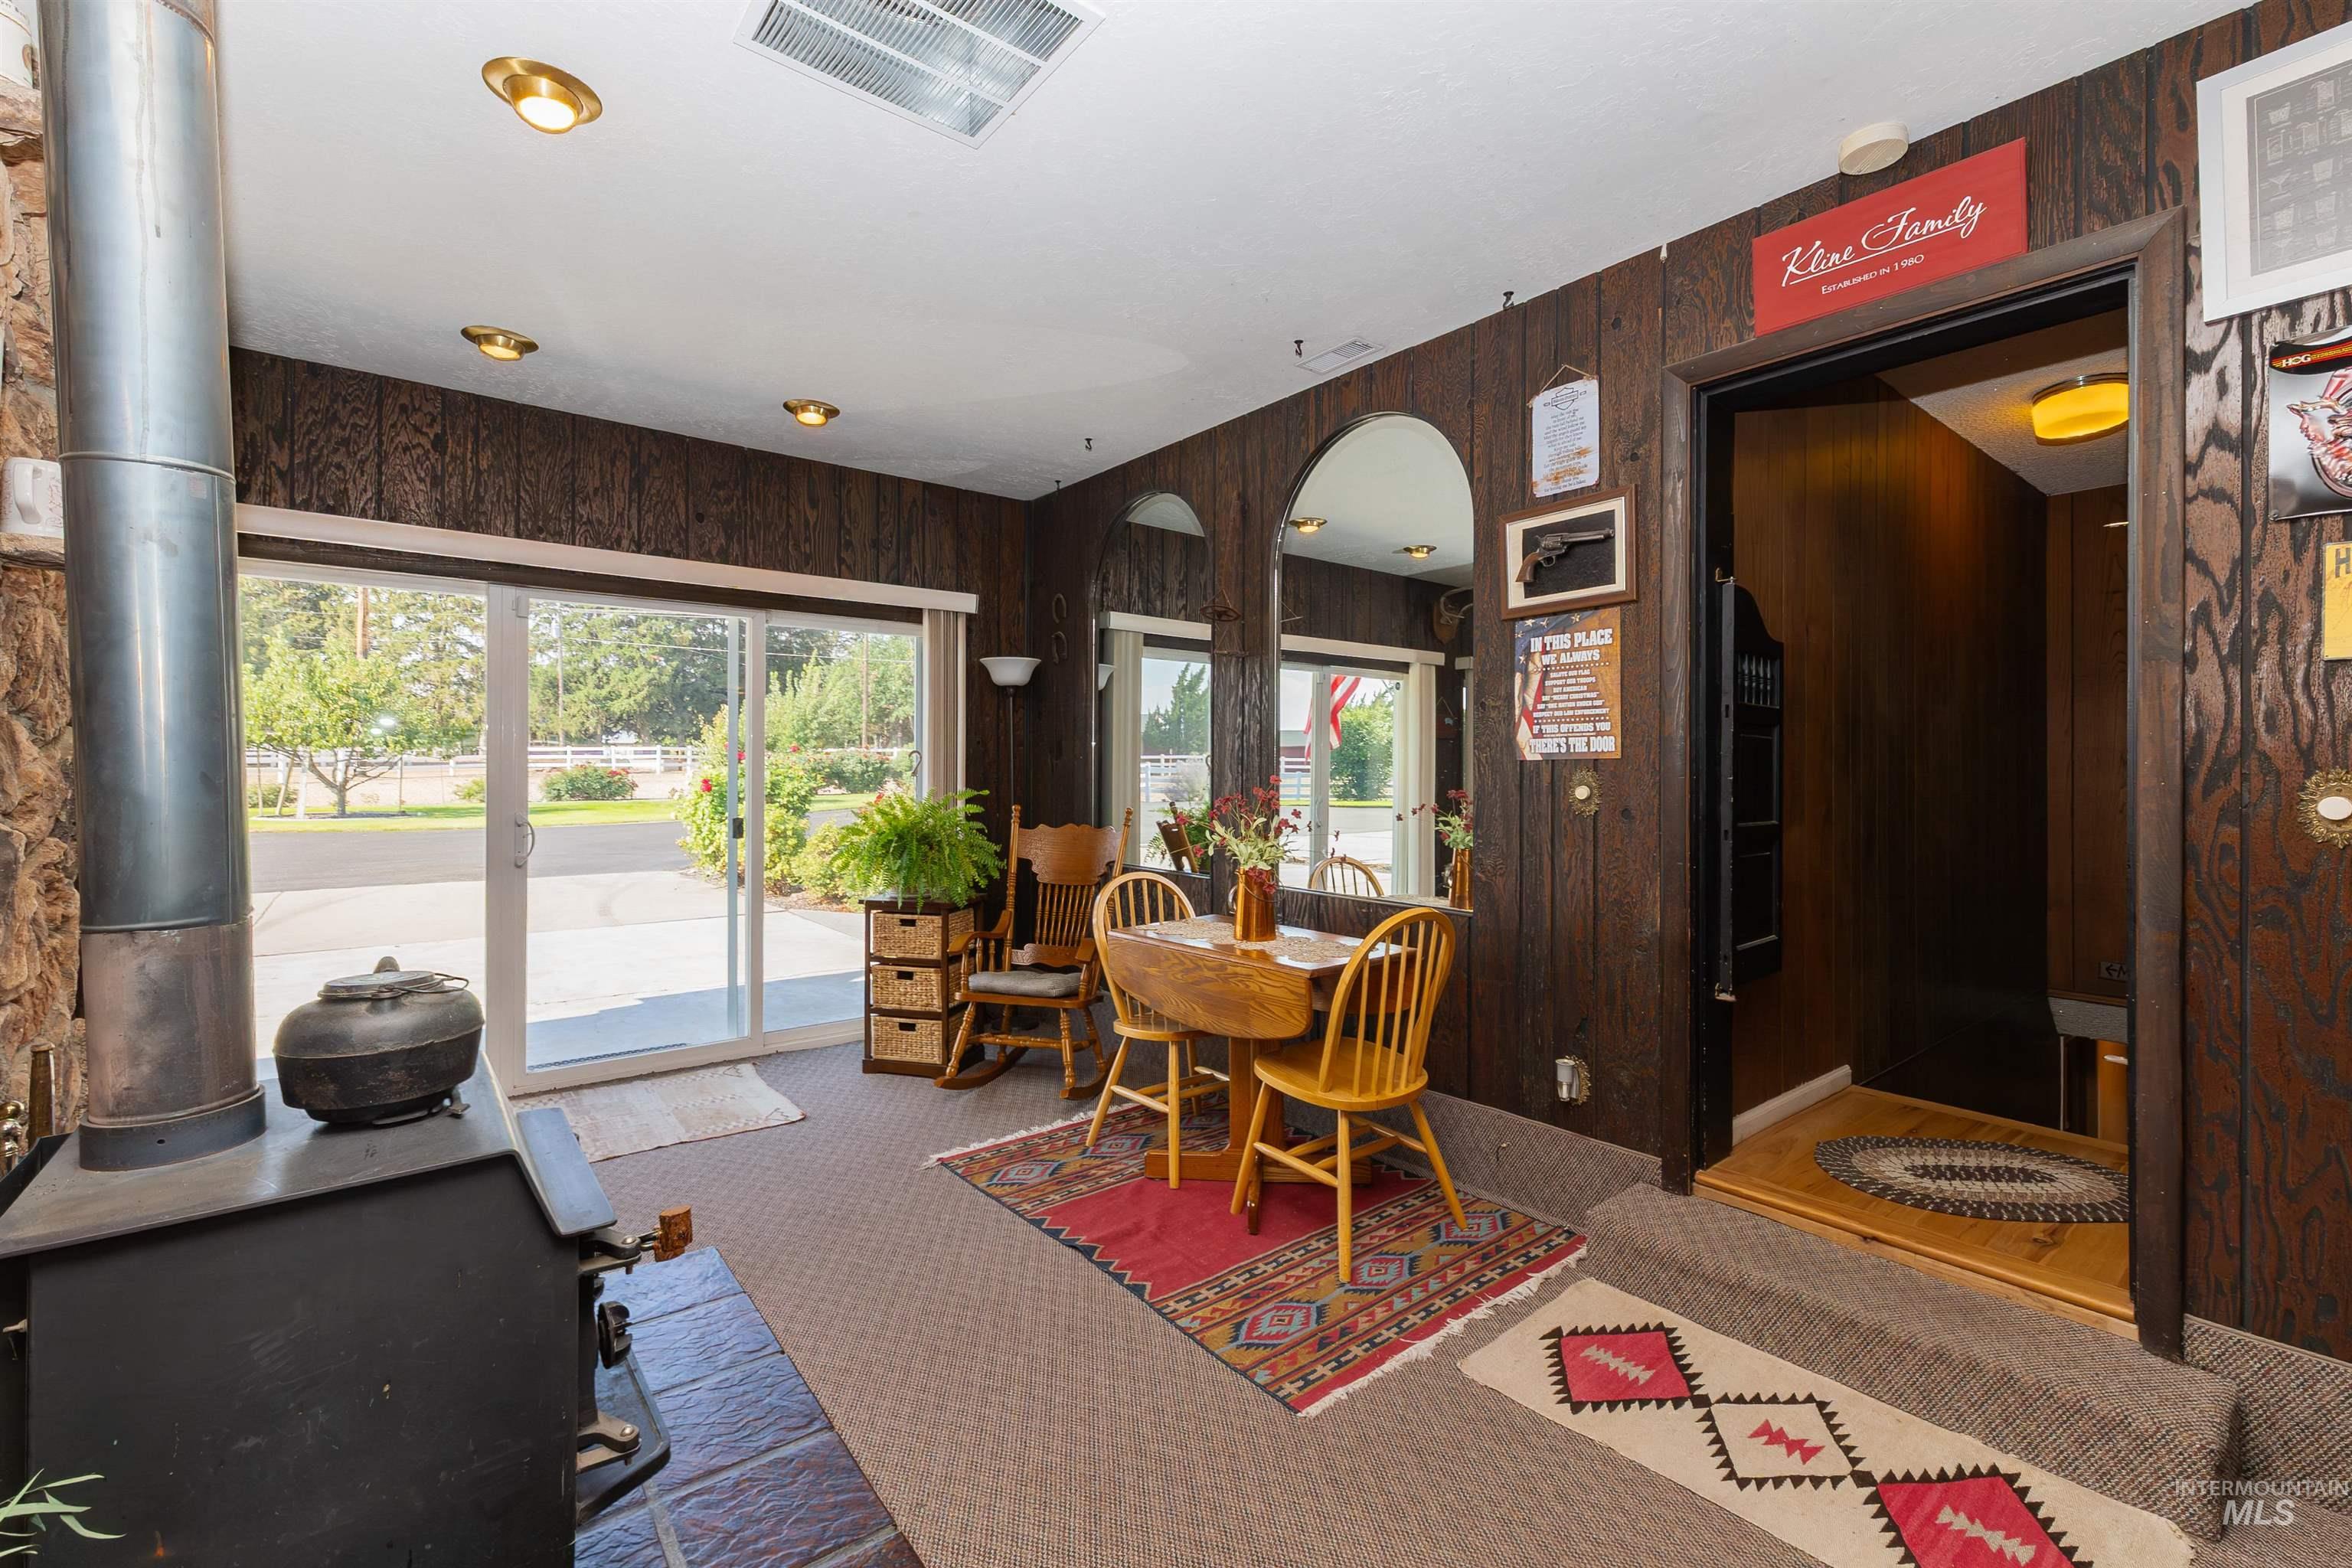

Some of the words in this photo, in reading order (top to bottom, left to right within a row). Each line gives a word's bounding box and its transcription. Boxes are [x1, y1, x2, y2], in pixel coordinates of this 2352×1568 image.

[1782, 240, 1855, 287] Kline
[1861, 195, 1988, 250] Family
[1880, 266, 1890, 276] IN
[1893, 254, 1924, 272] 1980
[2282, 354, 2311, 368] HOG
[1530, 636, 1542, 652] IN
[1544, 633, 1571, 651] THIS
[1573, 629, 1613, 648] PLACE
[1541, 654, 1557, 665] WE
[1560, 648, 1600, 664] ALWAYS
[1533, 725, 1540, 733] IF
[1540, 724, 1559, 733] THIS
[1560, 723, 1594, 733] OFFENDS
[1595, 722, 1611, 731] YOU
[1529, 737, 1566, 753] THERE'S
[1568, 737, 1588, 753] THE
[1589, 736, 1615, 752] DOOR
